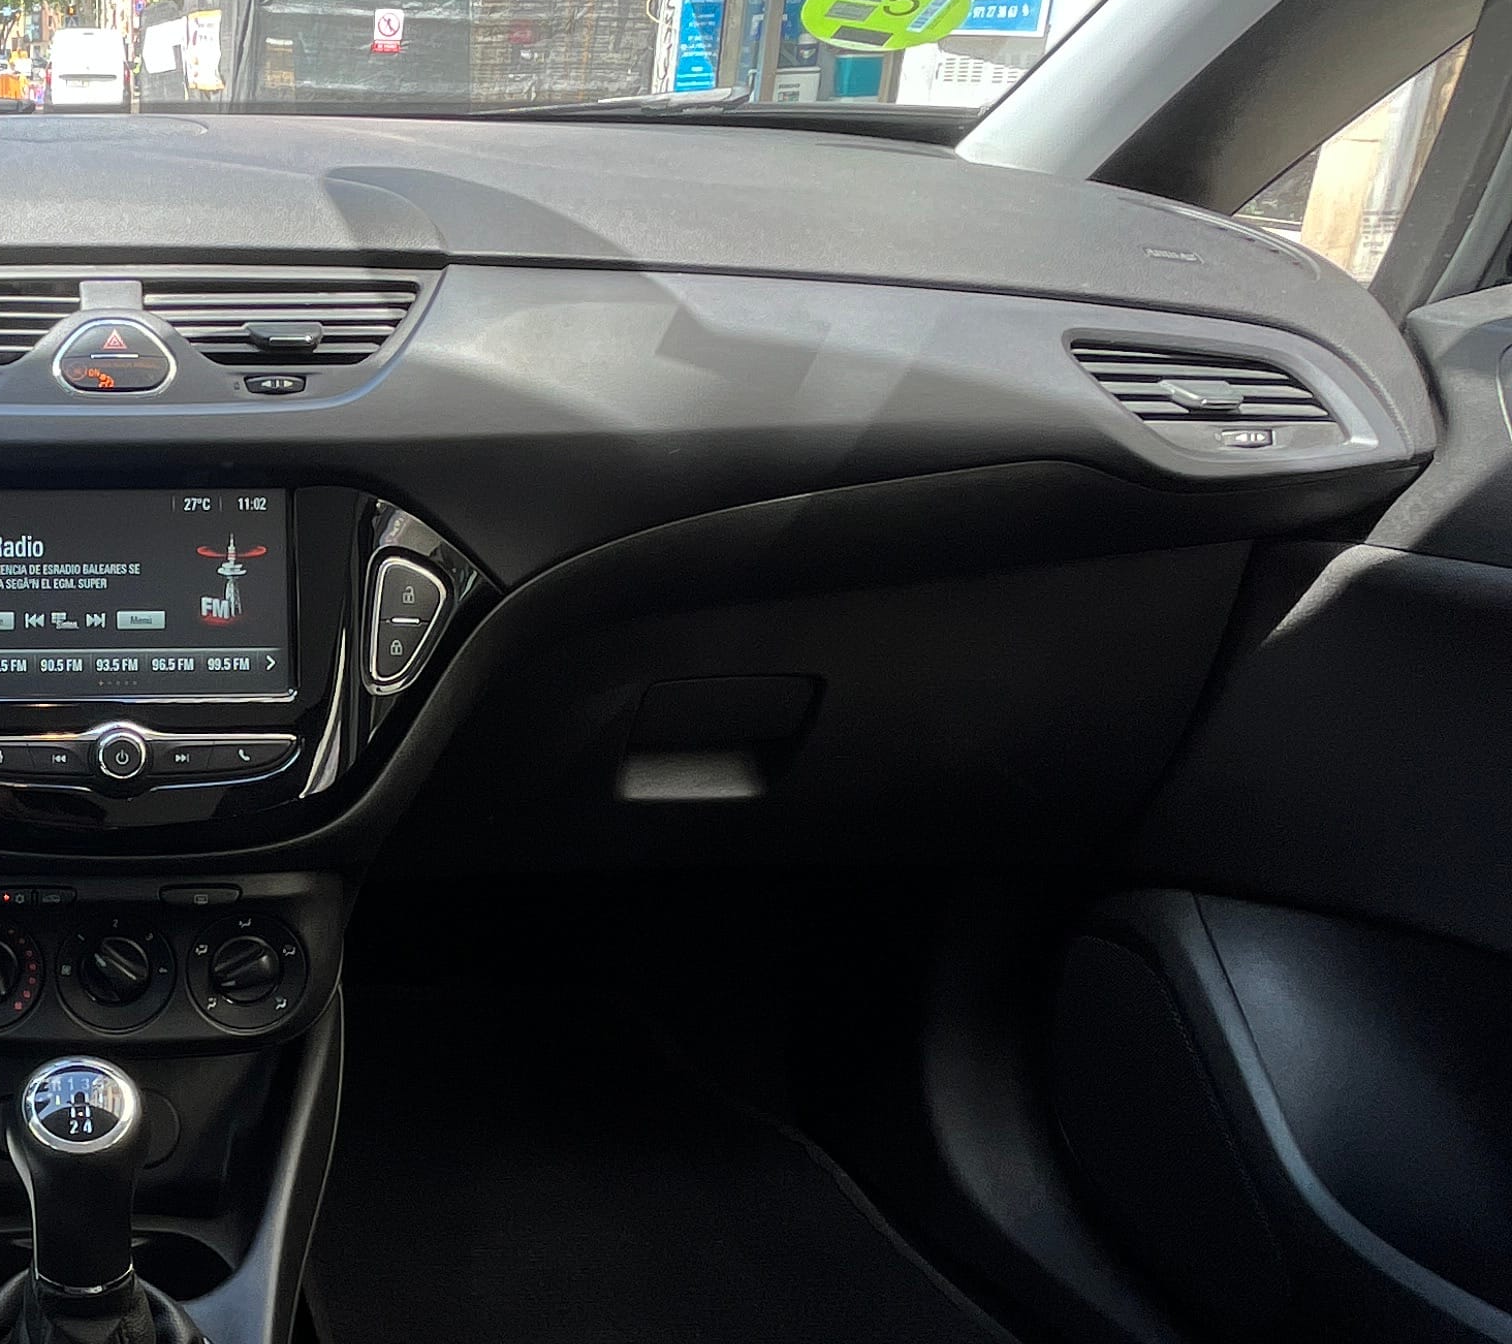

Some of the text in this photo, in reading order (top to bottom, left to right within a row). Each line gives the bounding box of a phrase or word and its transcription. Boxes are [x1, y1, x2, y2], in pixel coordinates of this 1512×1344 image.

[237, 497, 267, 511] 11:02
[29, 563, 41, 576] DE
[43, 563, 81, 576] ESRADIO
[82, 563, 127, 576] BALEARES
[128, 563, 140, 575] SE
[41, 578, 51, 589] EL
[78, 577, 107, 590] SUPER
[201, 597, 230, 619] FM
[10, 659, 27, 672] FM
[40, 659, 82, 672] 90.5 FM
[96, 659, 138, 672] 93.5 FM
[152, 659, 194, 672] 96.5 FM
[207, 659, 249, 672] 99.5 FM
[70, 1118, 93, 1135] 2 4
